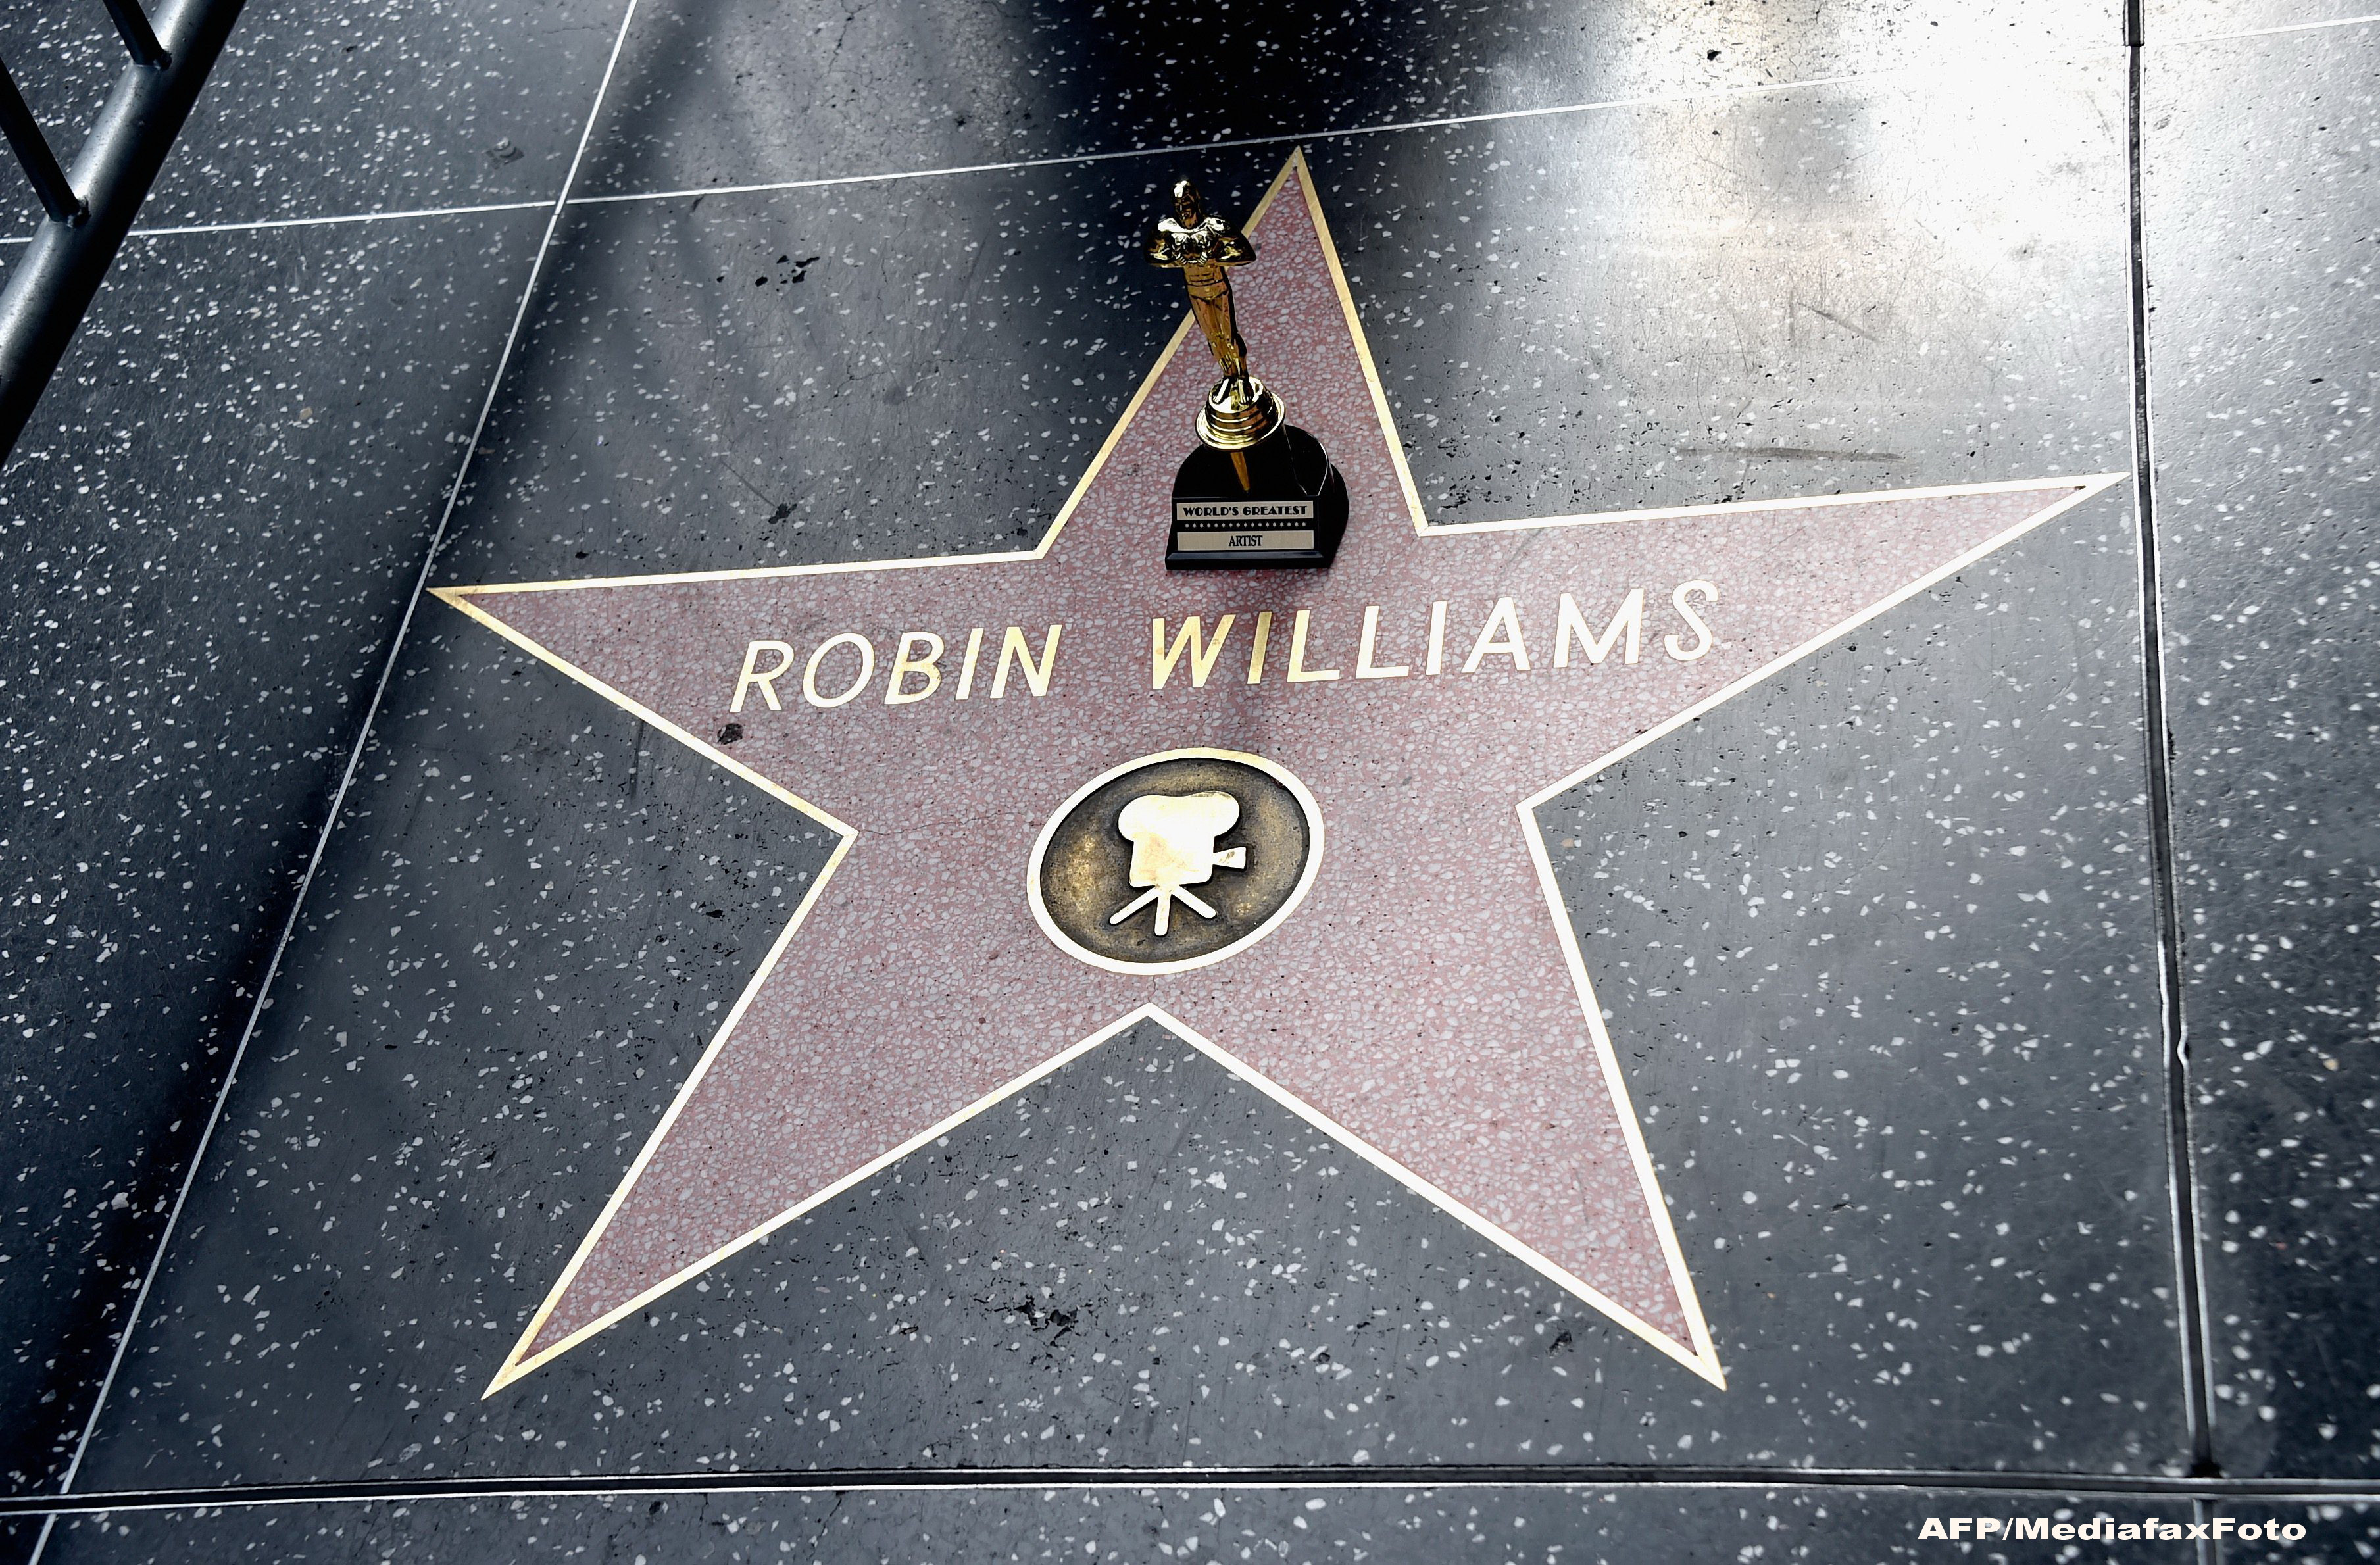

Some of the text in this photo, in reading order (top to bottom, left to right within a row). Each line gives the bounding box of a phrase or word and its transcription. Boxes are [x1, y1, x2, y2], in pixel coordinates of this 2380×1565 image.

[1183, 505, 1308, 516] WORLD'S GREATEST
[1228, 535, 1263, 547] ARTIST
[730, 580, 1718, 713] ROBIN WILLIAMS
